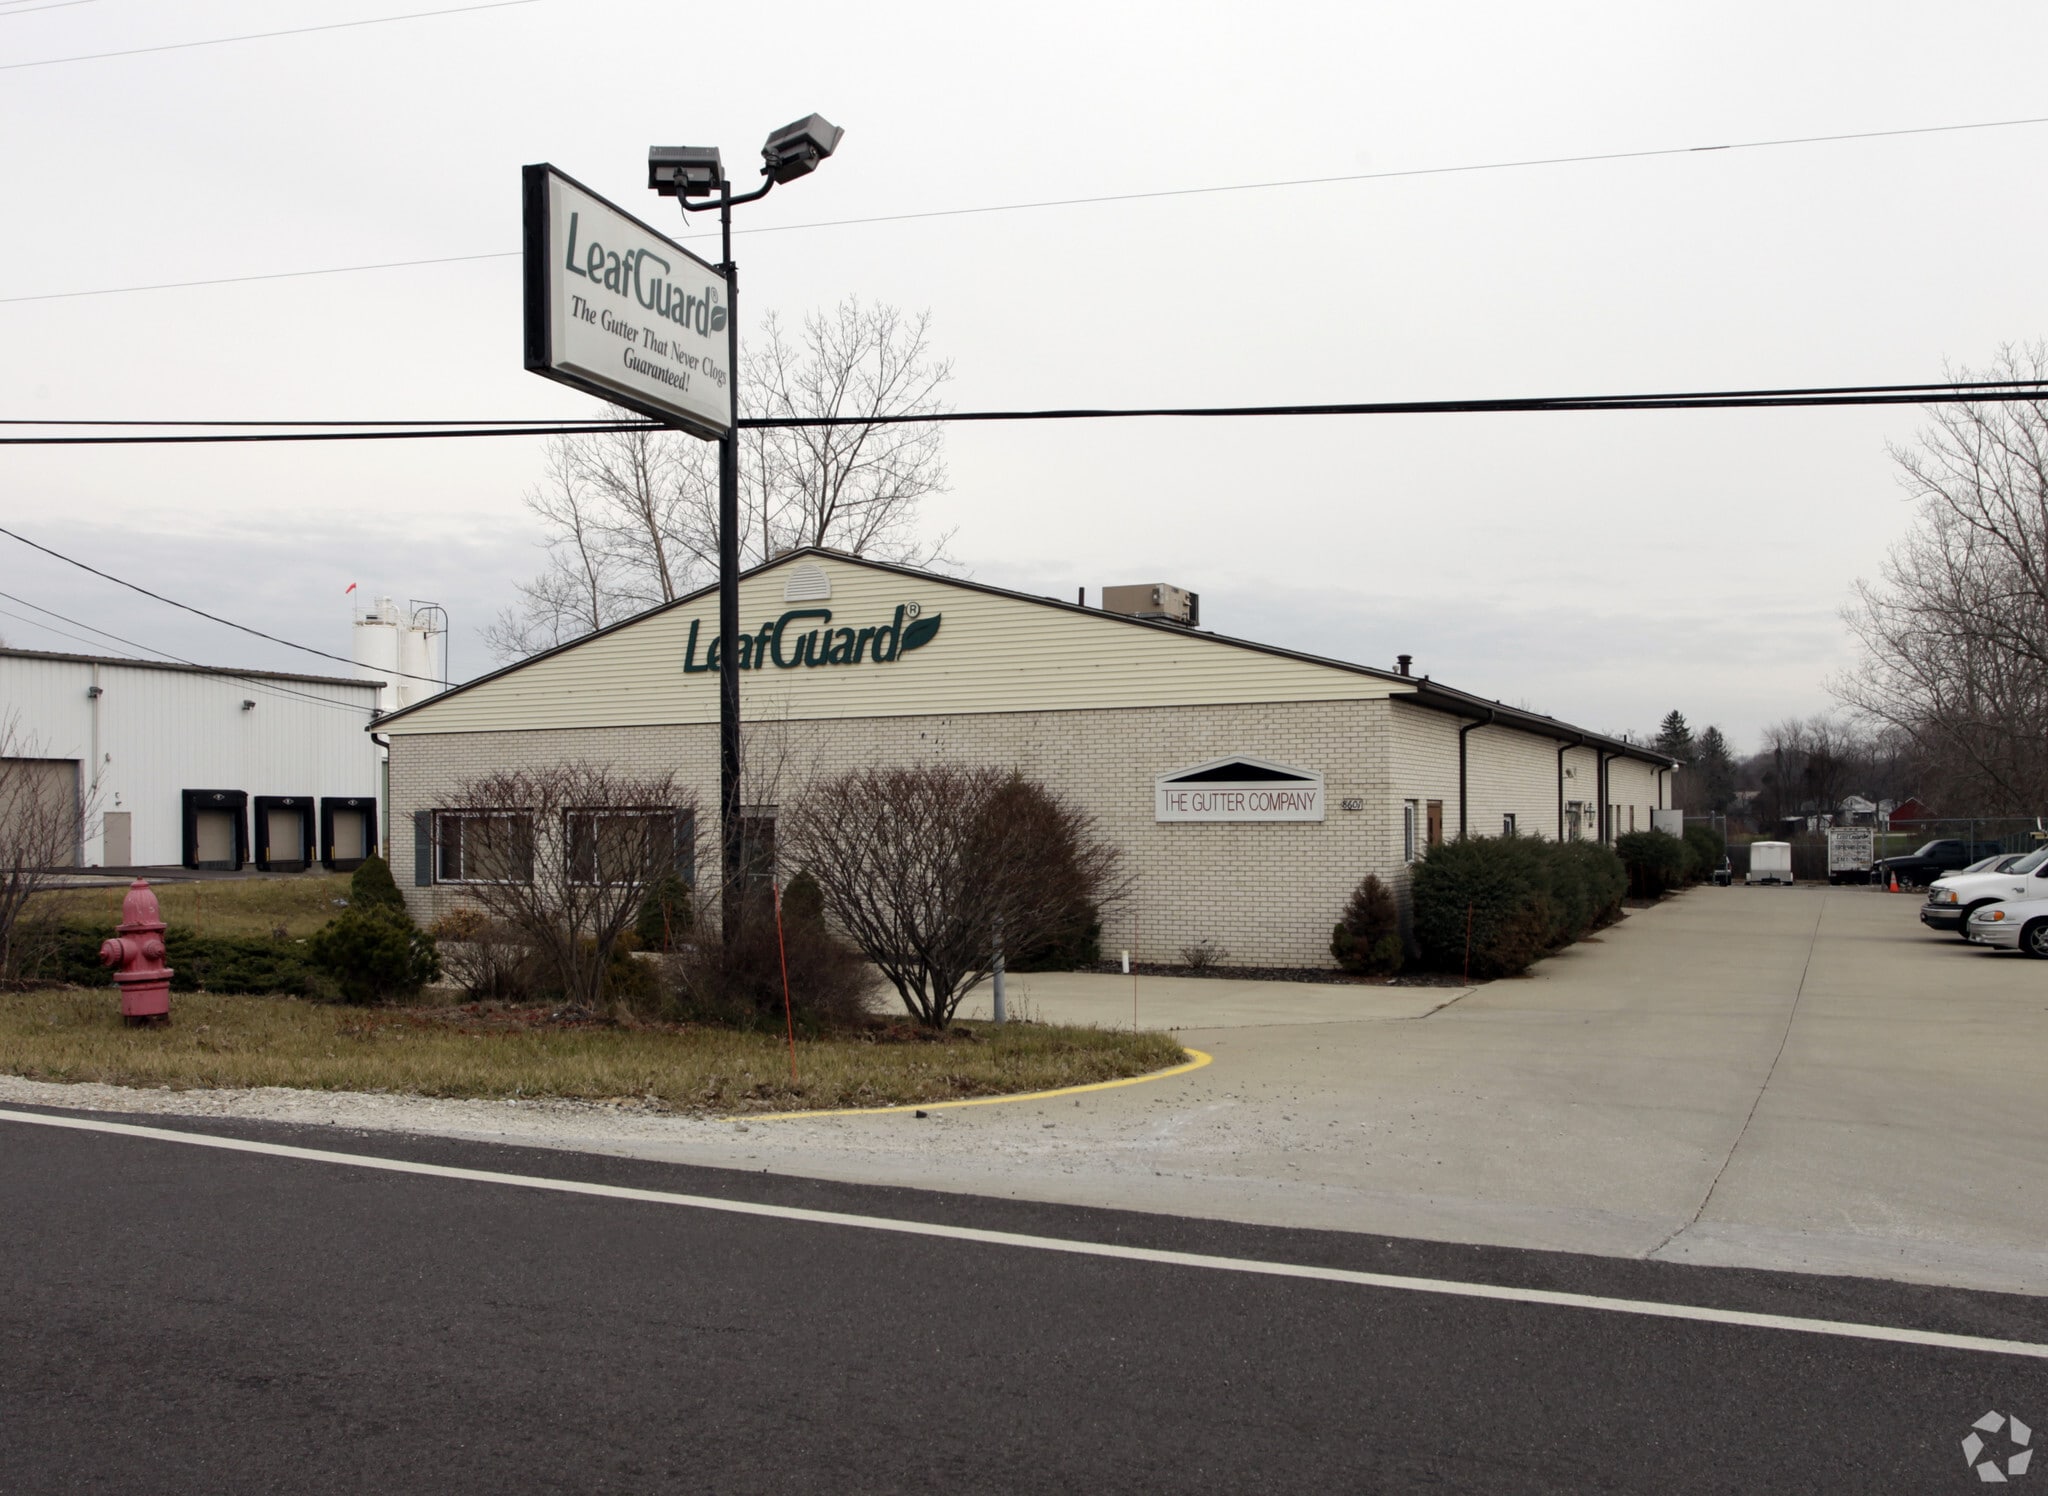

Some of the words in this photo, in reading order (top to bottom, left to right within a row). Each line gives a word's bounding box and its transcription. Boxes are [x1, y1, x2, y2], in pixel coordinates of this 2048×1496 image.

[572, 295, 597, 325] The
[601, 309, 638, 343] Gutter
[643, 327, 668, 357] That
[671, 341, 699, 370] Never
[702, 356, 726, 388] Clogs
[623, 347, 690, 392] Guaranteed!
[1162, 790, 1188, 812] THE
[1192, 793, 1245, 812] GUTTER
[1248, 792, 1316, 811] COMPANY
